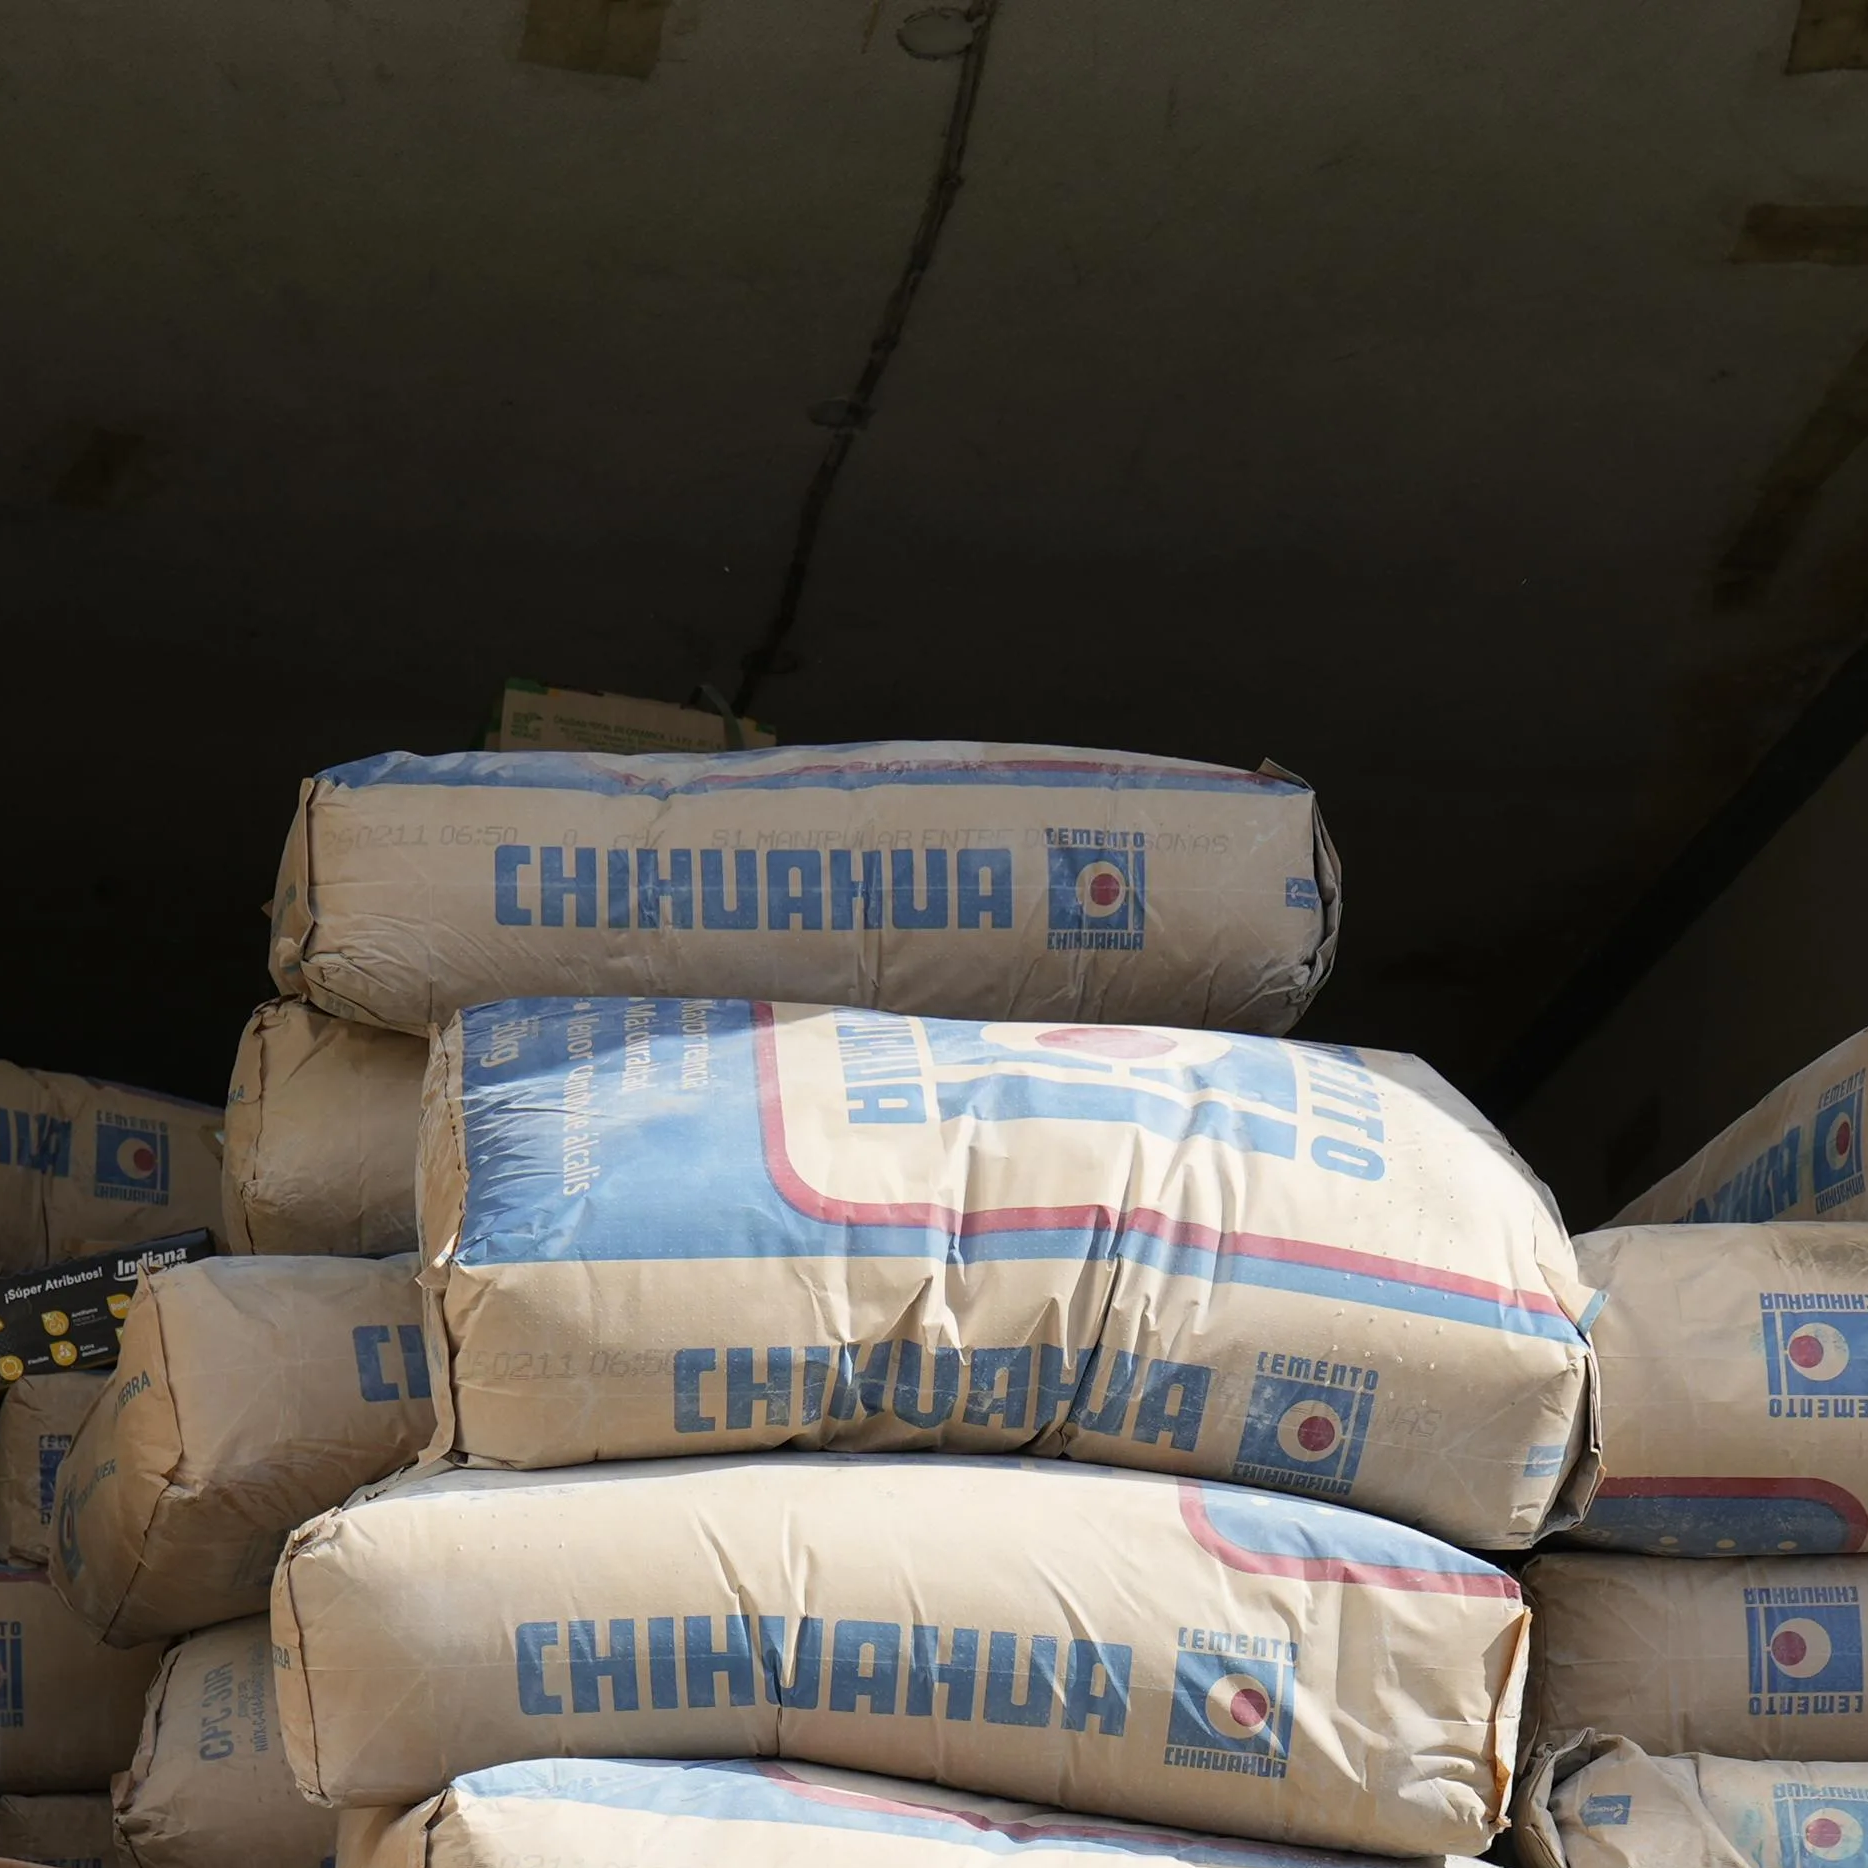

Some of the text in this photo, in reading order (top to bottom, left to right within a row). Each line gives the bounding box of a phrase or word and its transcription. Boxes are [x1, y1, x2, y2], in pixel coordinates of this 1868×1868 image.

[1046, 827, 1145, 848] CEMENTO
[493, 843, 1013, 931] CHIHUAHUA
[1046, 930, 1144, 951] CHIHUAHUA
[1817, 1067, 1867, 1111] CEMENTO
[95, 1109, 170, 1133] CEMENTO
[93, 1182, 170, 1206] CHIHUAHUA
[1814, 1172, 1867, 1215] CHIHUAHUA
[4, 1266, 103, 1304] ¡Súper Atributos!
[1256, 1351, 1380, 1391] CEMENTO
[674, 1341, 1215, 1452] CHIHUAHUA
[1232, 1461, 1352, 1497] CHIHUAHUA
[1742, 1585, 1859, 1604] CHIHUAHUA
[1177, 1626, 1299, 1666] CEMENTO
[515, 1614, 1132, 1736] CHIHUAHUA
[1748, 1694, 1863, 1715] CEMENTO
[1164, 1745, 1287, 1779] CHIHUAHUA
